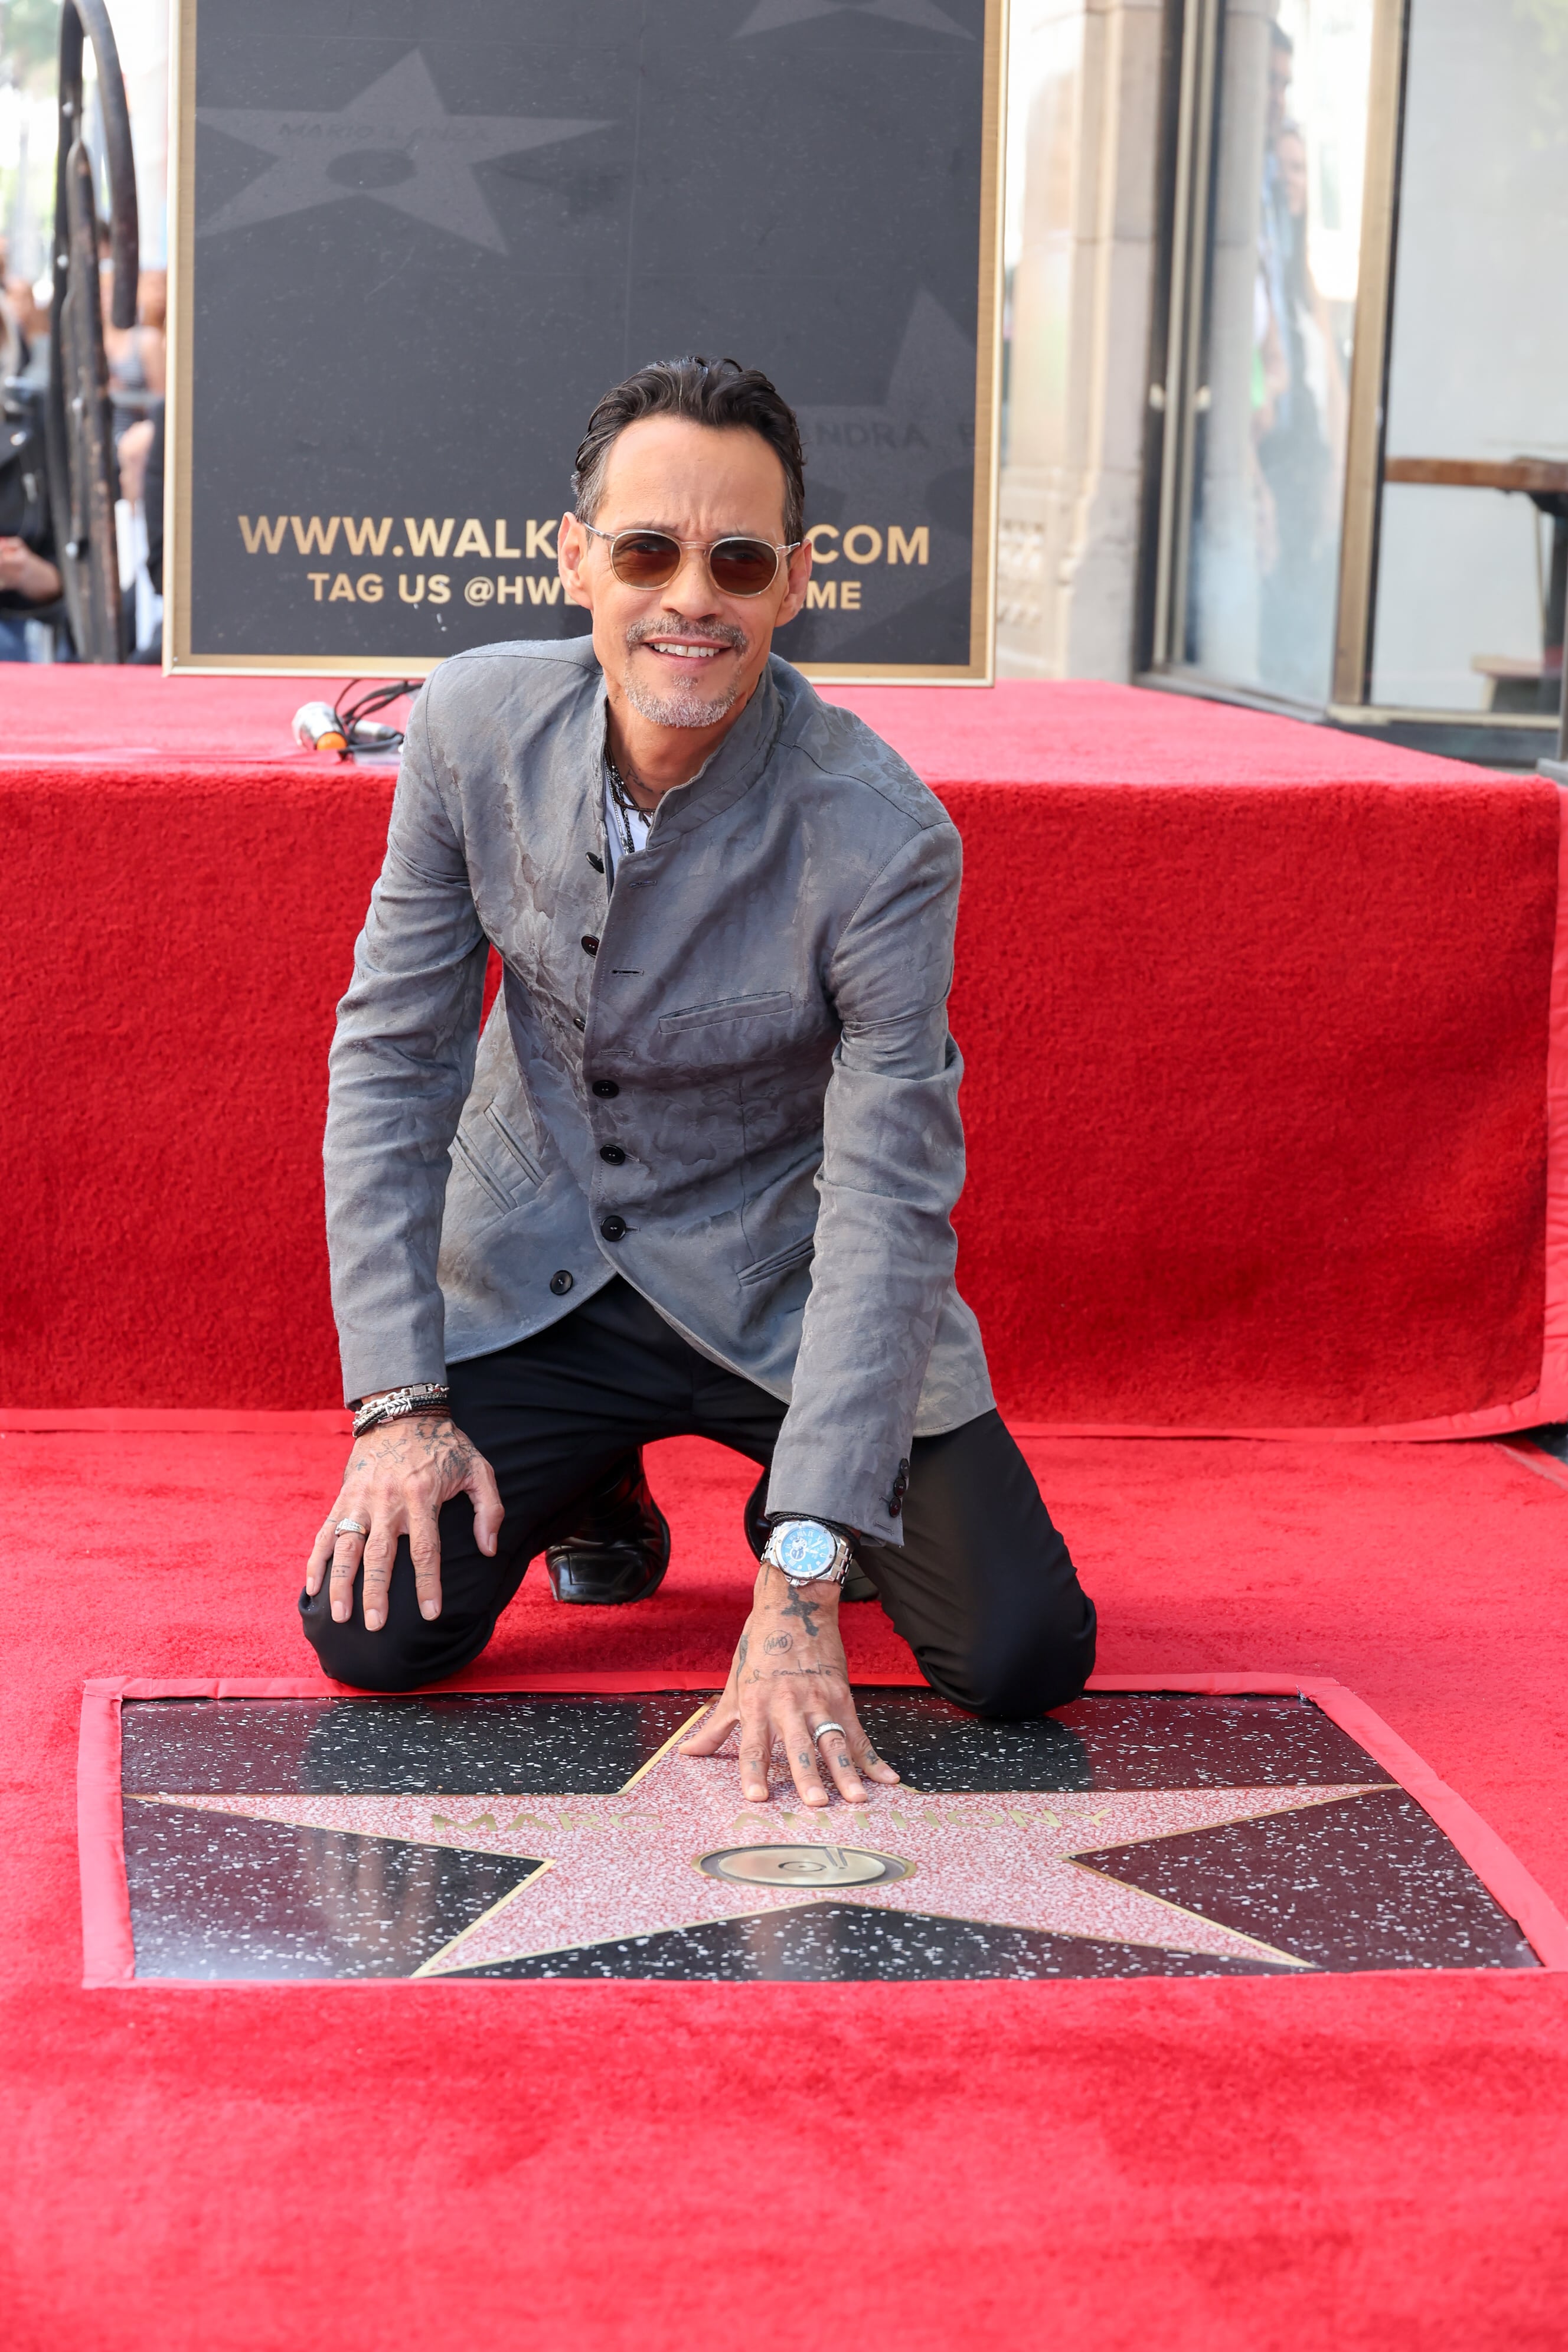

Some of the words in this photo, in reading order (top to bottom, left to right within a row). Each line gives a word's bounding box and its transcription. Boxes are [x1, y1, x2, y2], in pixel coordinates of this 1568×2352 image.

[307, 572, 384, 602] TAG
[398, 574, 452, 603] US
[432, 1812, 665, 1831] MARC
[732, 1808, 1113, 1830] ANTHONY
